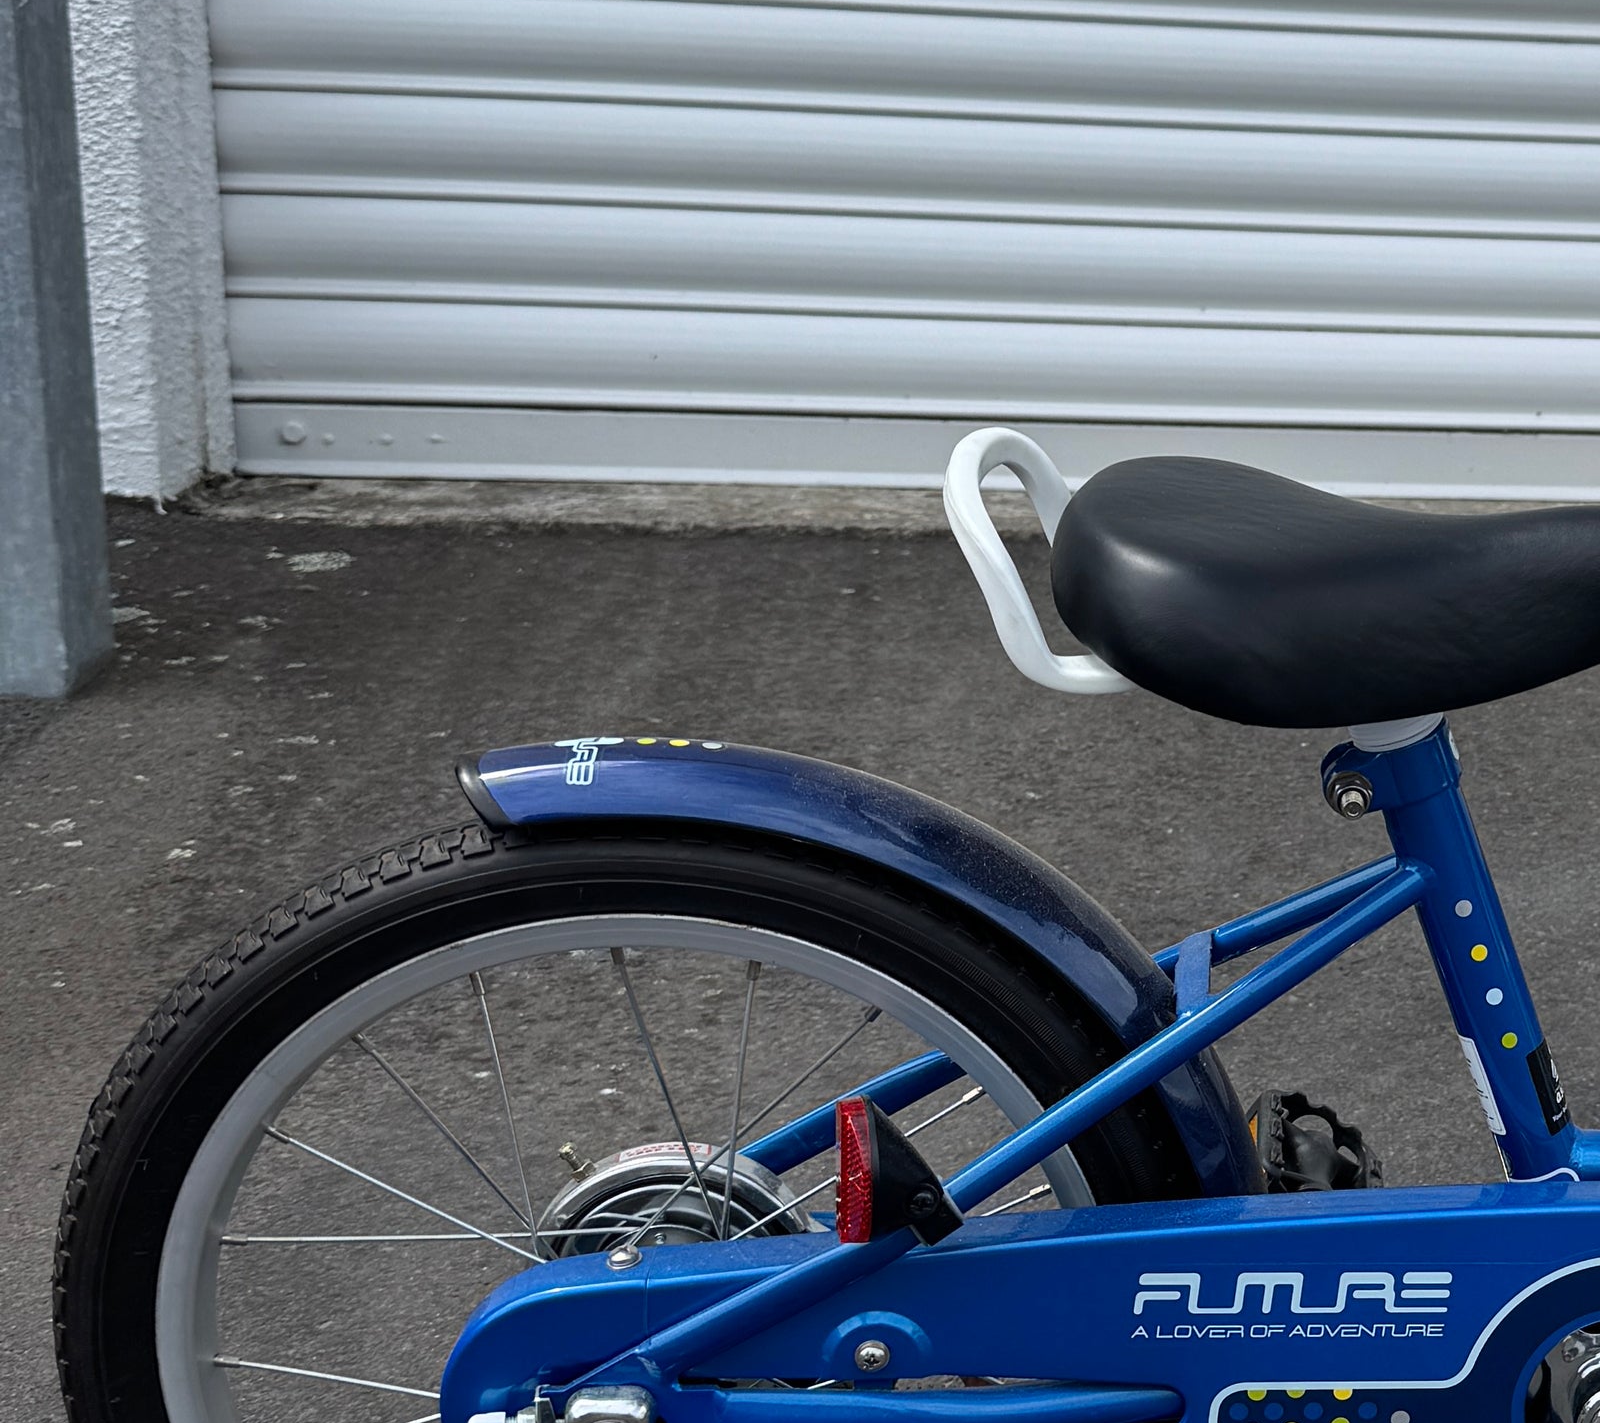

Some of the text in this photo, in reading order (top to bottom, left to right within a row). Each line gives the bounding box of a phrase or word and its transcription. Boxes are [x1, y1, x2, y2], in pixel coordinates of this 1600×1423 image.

[1133, 1271, 1453, 1315] FUTURE
[1130, 1323, 1446, 1339] A LOVER OF ADVENTURE
